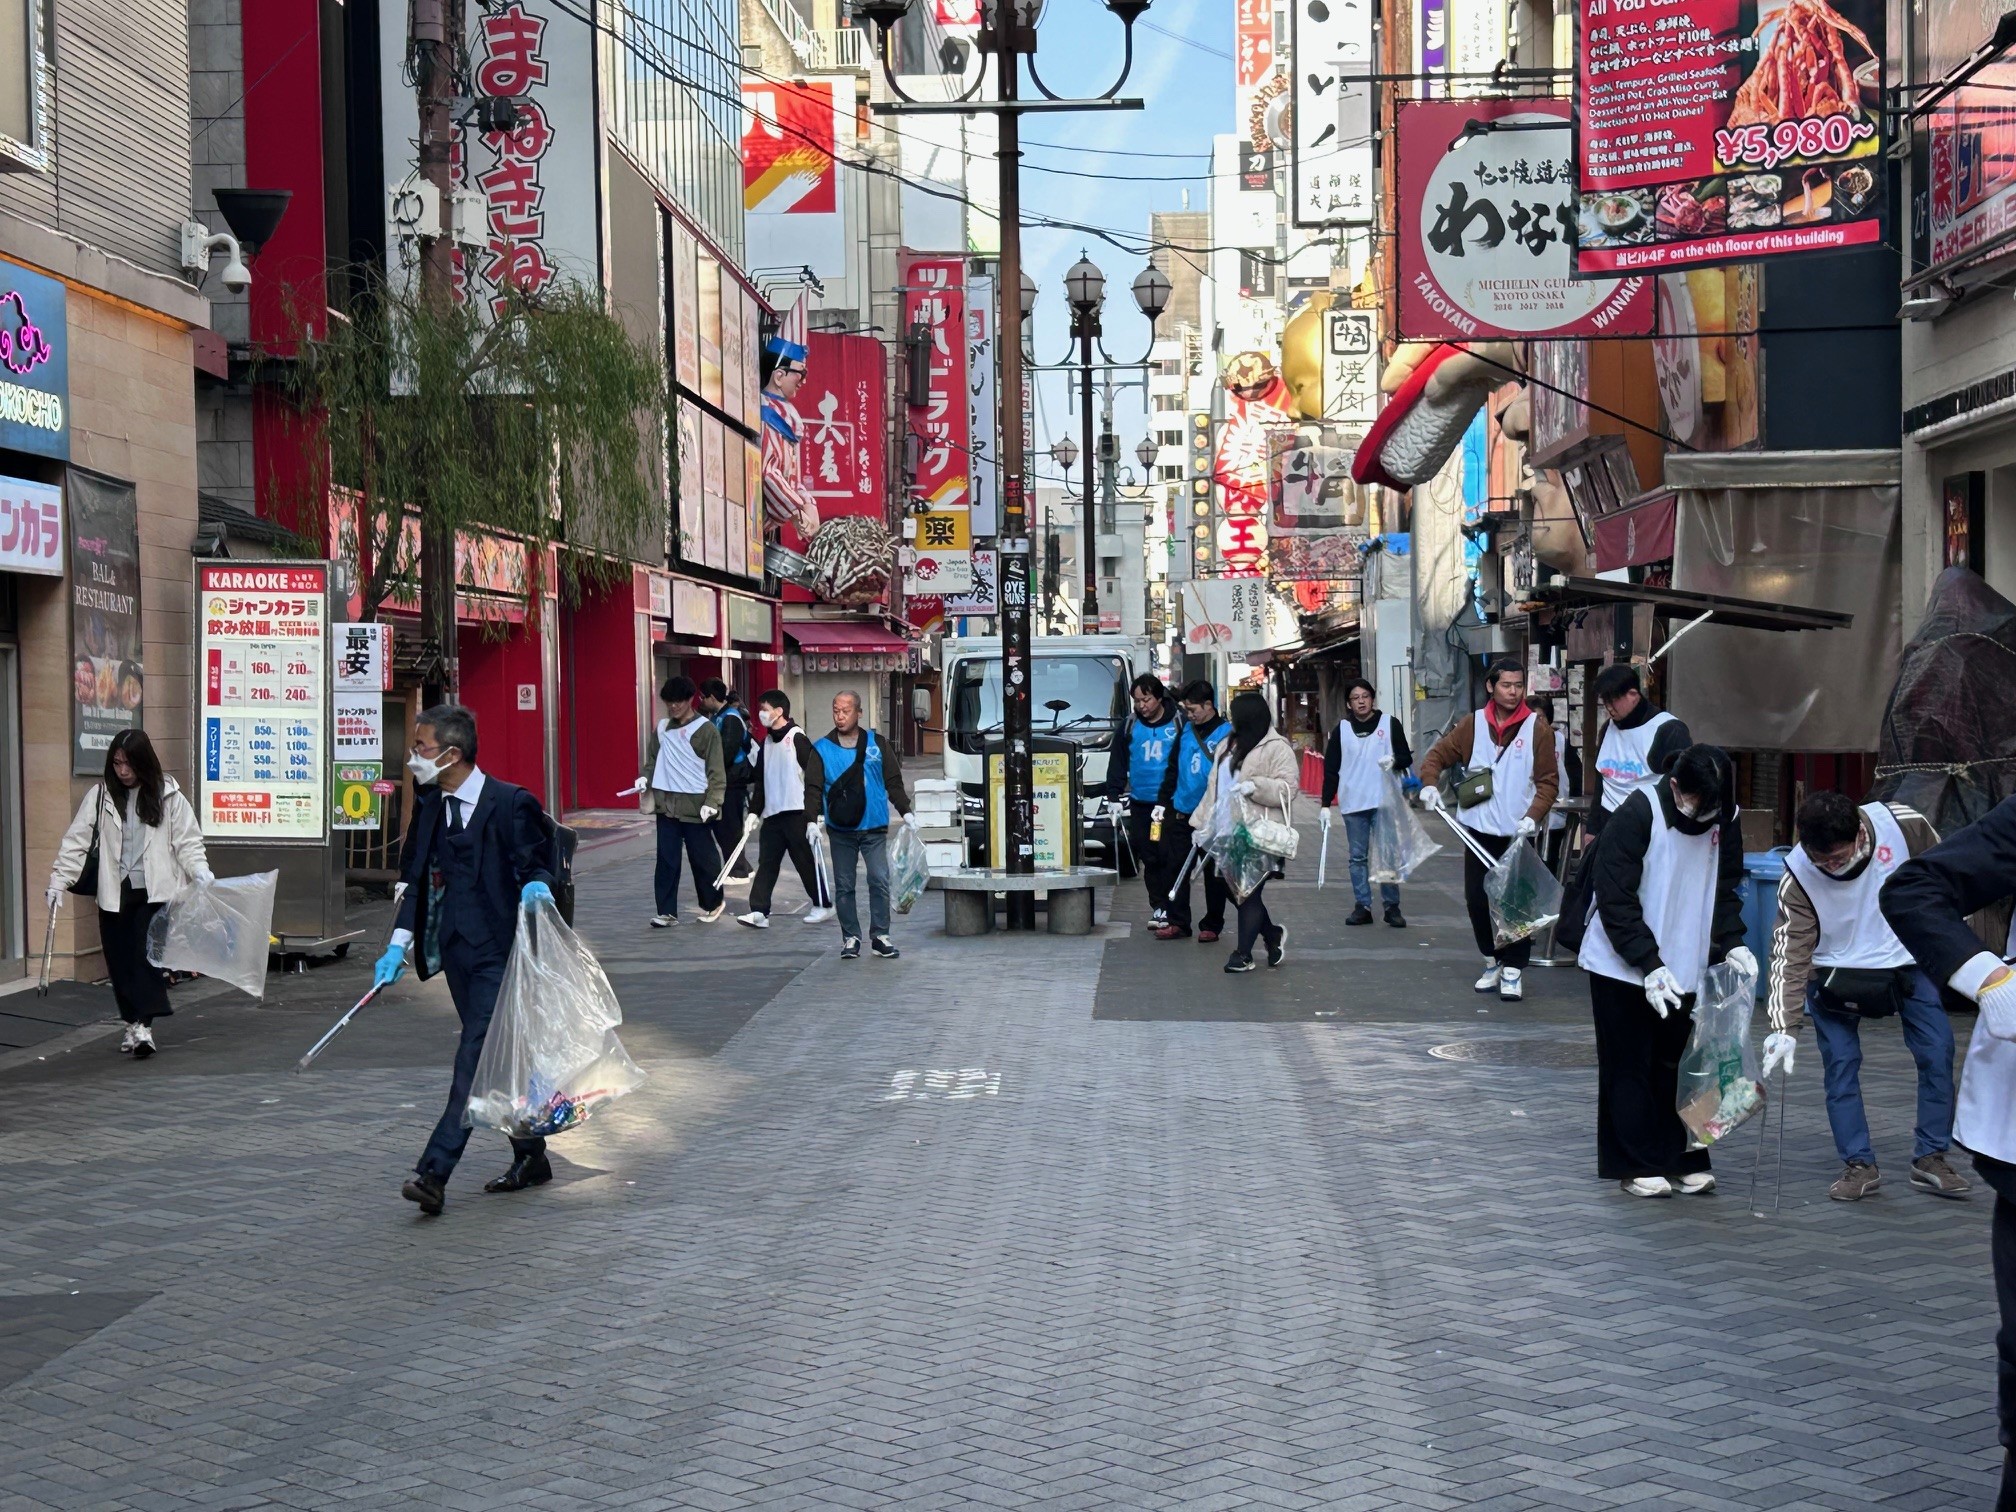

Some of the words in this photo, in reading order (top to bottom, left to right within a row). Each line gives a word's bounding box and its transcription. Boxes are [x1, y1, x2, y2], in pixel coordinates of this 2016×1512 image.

[1658, 71, 1687, 83] Grilled
[1589, 96, 1610, 106] Crab
[1611, 93, 1625, 102] Hot
[1647, 87, 1668, 97] Crab
[1625, 102, 1641, 112] and
[1644, 102, 1655, 110] an
[1629, 114, 1638, 124] of
[1641, 113, 1652, 122] 10
[1653, 110, 1670, 120] Hot
[1670, 249, 1685, 259] on
[1686, 244, 1704, 257] the
[1705, 240, 1723, 254] 4th
[1726, 239, 1754, 252] floor
[1755, 236, 1769, 249] of
[1770, 234, 1793, 248] this
[1795, 230, 1844, 246] building
[1479, 279, 1540, 291] MICHELIN
[1544, 278, 1584, 289] GUIDE
[1413, 272, 1477, 336] TAKOYAKI
[1591, 276, 1643, 329] WANAK
[1493, 291, 1529, 301] KYOTO
[1532, 290, 1566, 300] OSAKA
[1336, 323, 1366, 346] 牛角
[1336, 361, 1366, 412] 焼肉
[925, 517, 955, 546] 薬
[208, 572, 289, 590] KARAOKE
[1004, 581, 1026, 593] OYE
[74, 585, 134, 615] RESTAURANT
[229, 598, 306, 615] ジャンカラ
[1004, 593, 1026, 605] RUNS
[345, 627, 371, 676] 最安
[1141, 740, 1163, 762] 14
[212, 810, 238, 824] FREE
